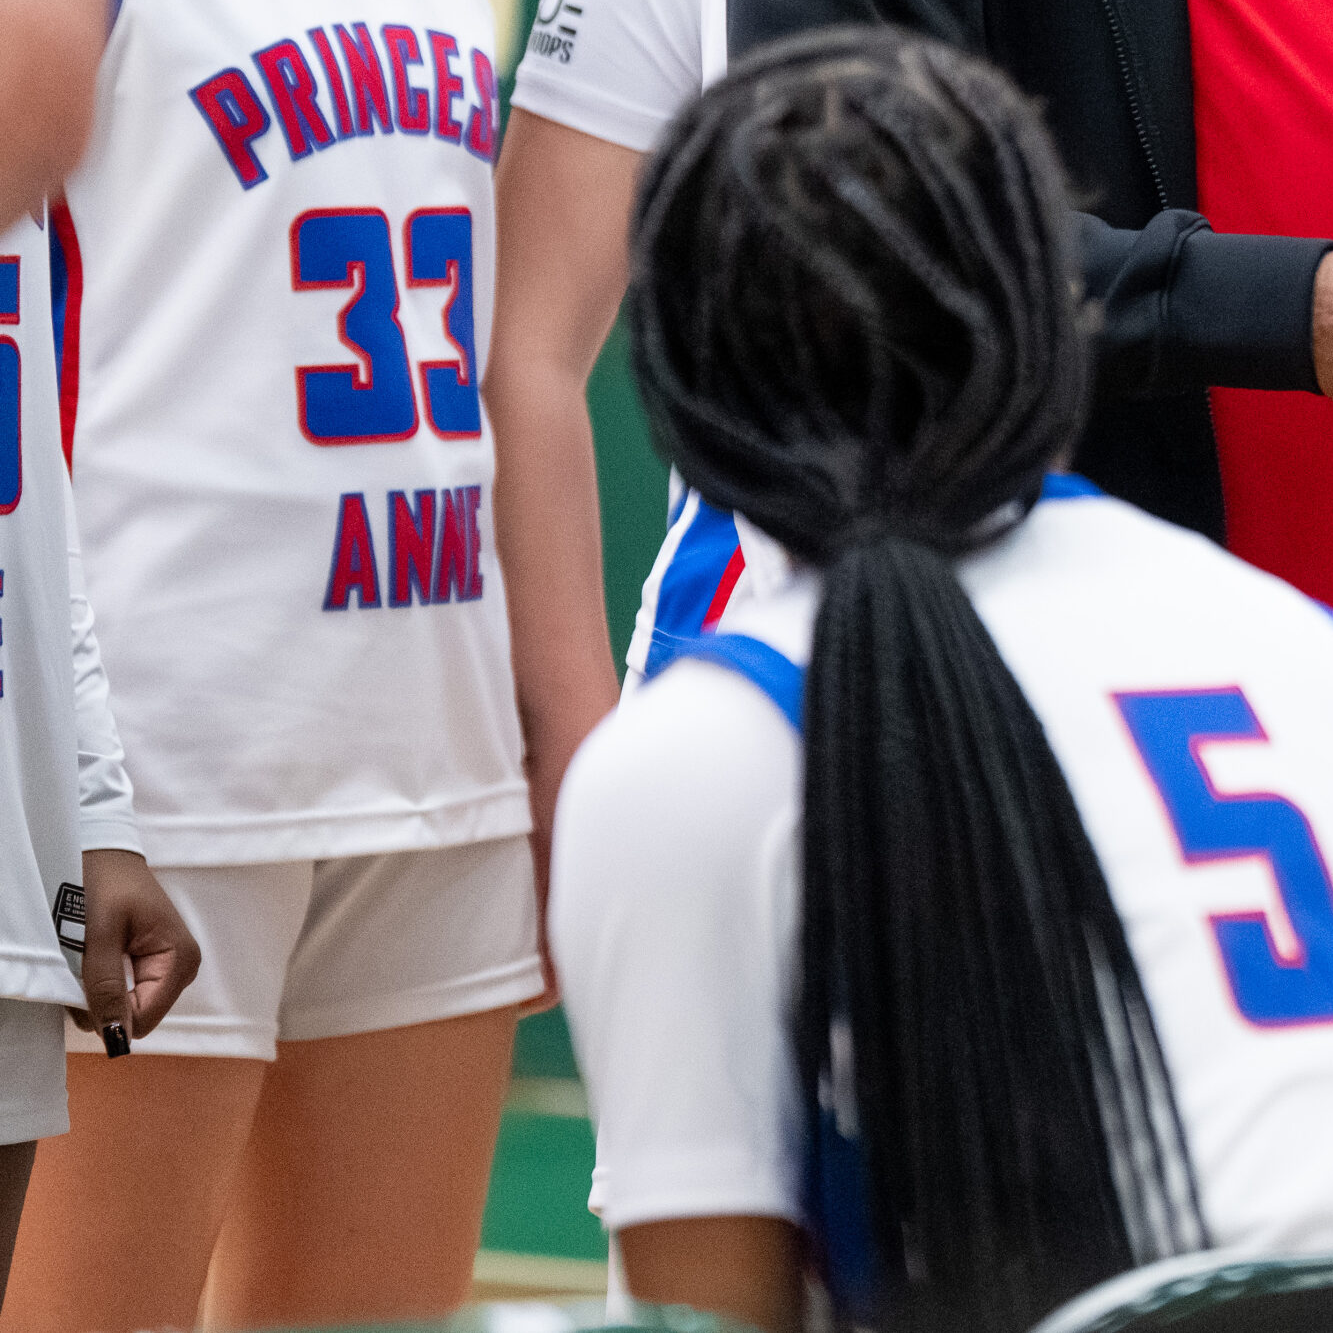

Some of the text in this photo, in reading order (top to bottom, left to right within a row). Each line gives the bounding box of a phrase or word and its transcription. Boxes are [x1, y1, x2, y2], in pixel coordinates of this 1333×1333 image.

[187, 22, 503, 192] PRINCES
[289, 205, 482, 446] 33
[321, 484, 484, 611] ANNE
